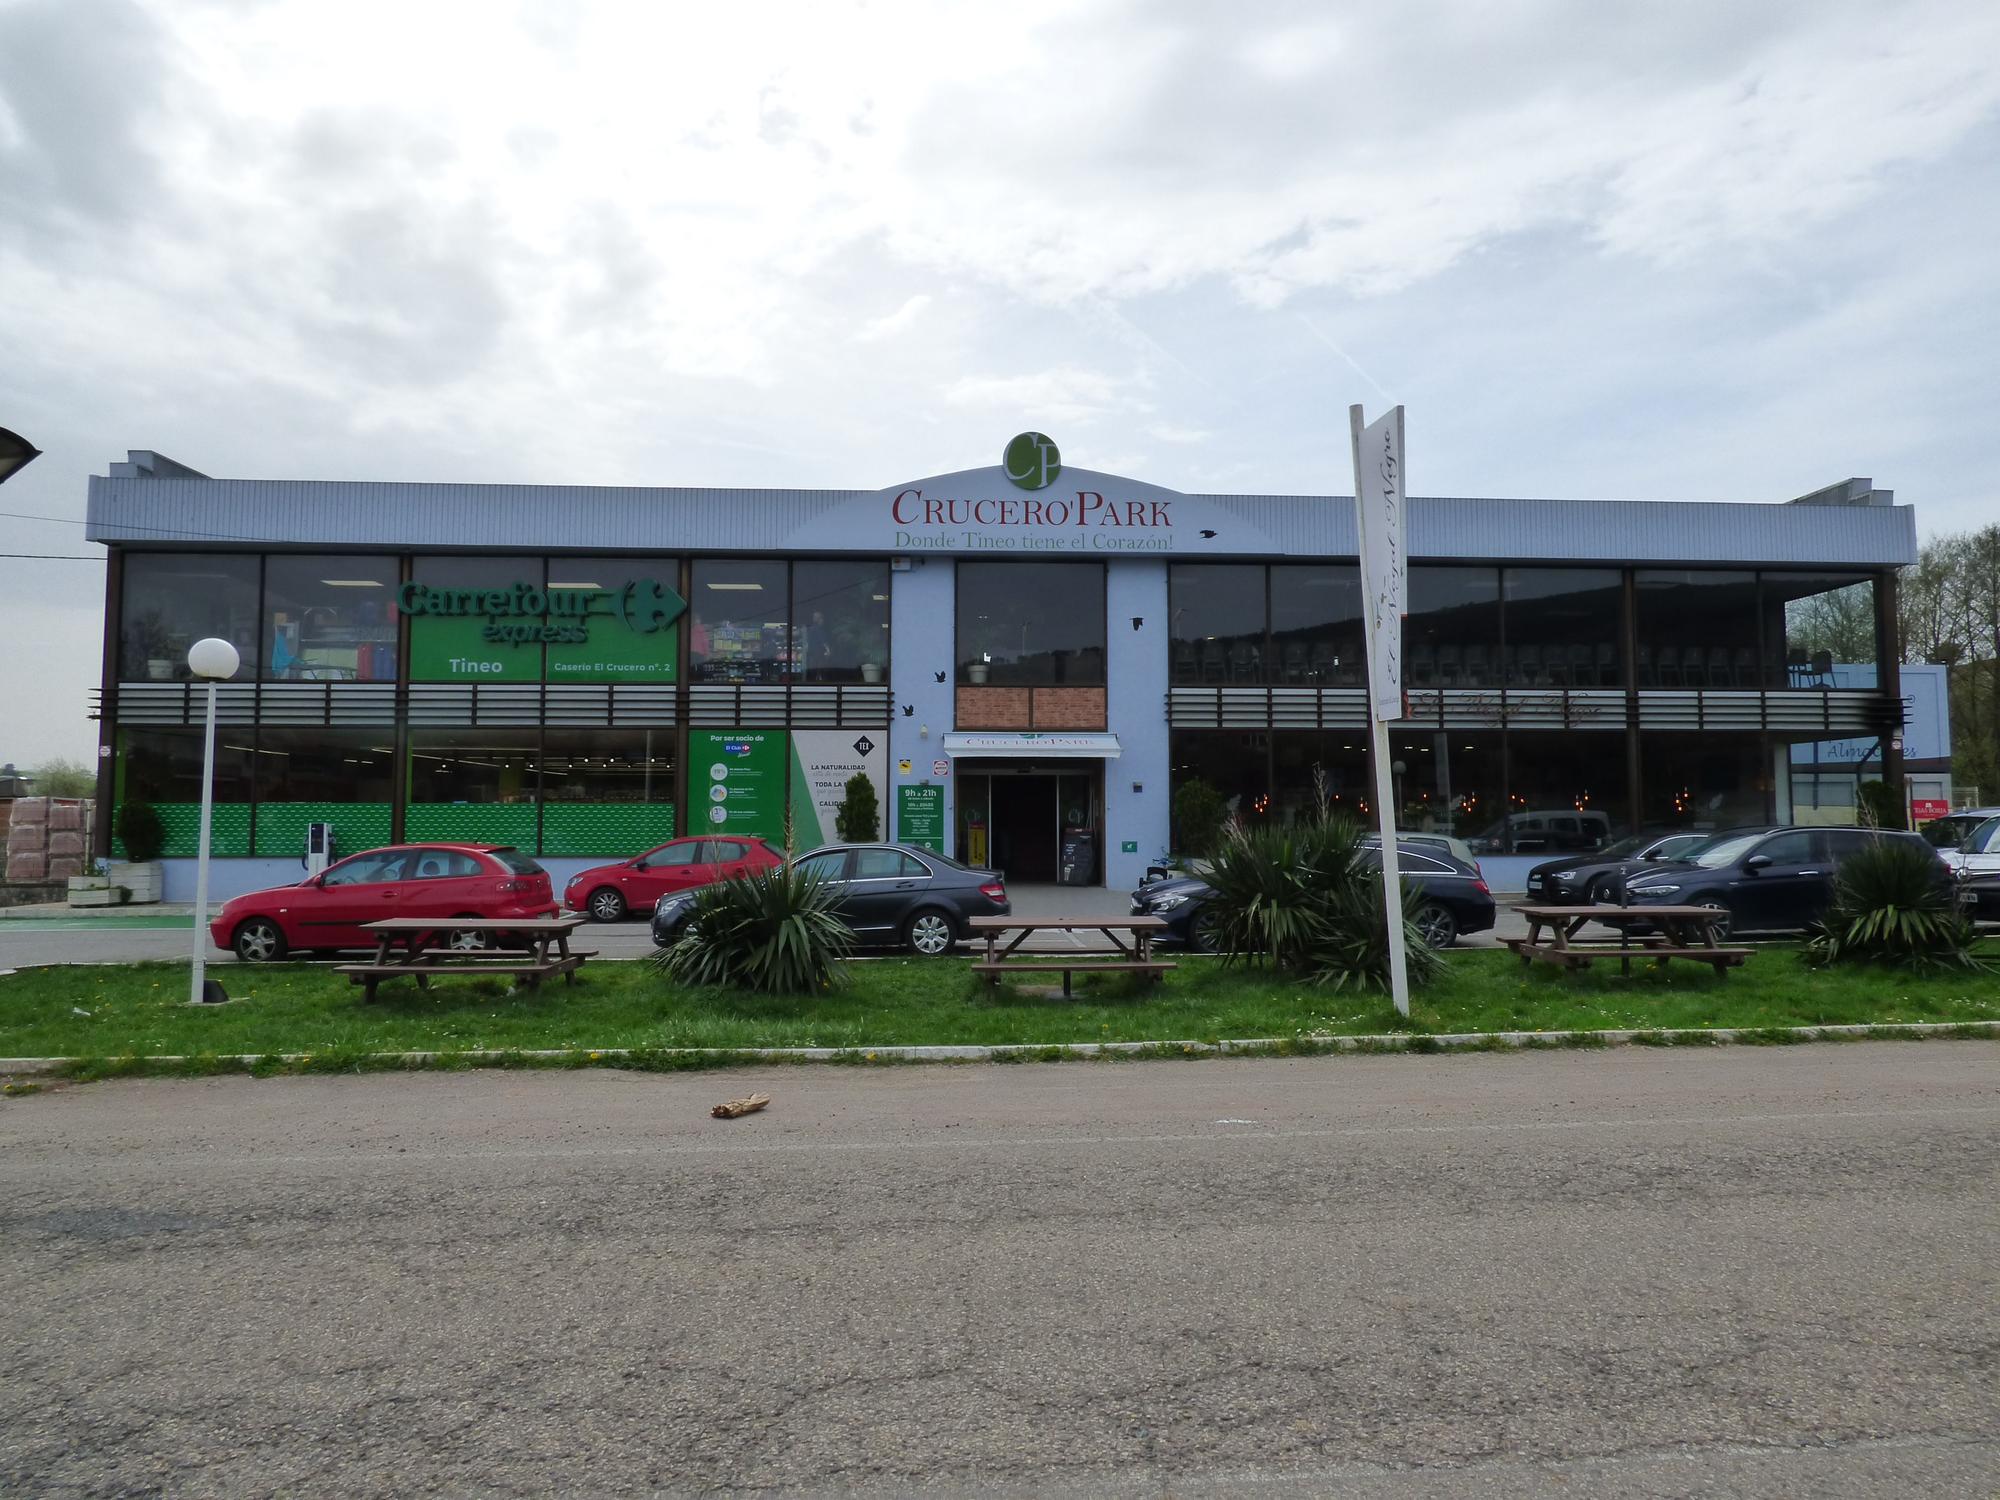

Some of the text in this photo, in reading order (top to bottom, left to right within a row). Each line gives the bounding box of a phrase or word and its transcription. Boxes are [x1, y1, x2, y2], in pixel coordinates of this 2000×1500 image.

[1003, 432, 1061, 488] CP
[1380, 427, 1398, 528] Negro
[892, 489, 1173, 527] CRUCERO'PARK
[895, 531, 1174, 550] Donde Tineo tiene el Corazón!
[400, 580, 595, 617] Carrefour
[482, 623, 590, 648] express
[449, 658, 503, 673] Tineo
[594, 663, 603, 671] El
[606, 663, 645, 672] Crucero
[664, 663, 671, 671] 2
[859, 742, 869, 750] TEX
[905, 789, 916, 797] 9h
[922, 789, 937, 797] 21h
